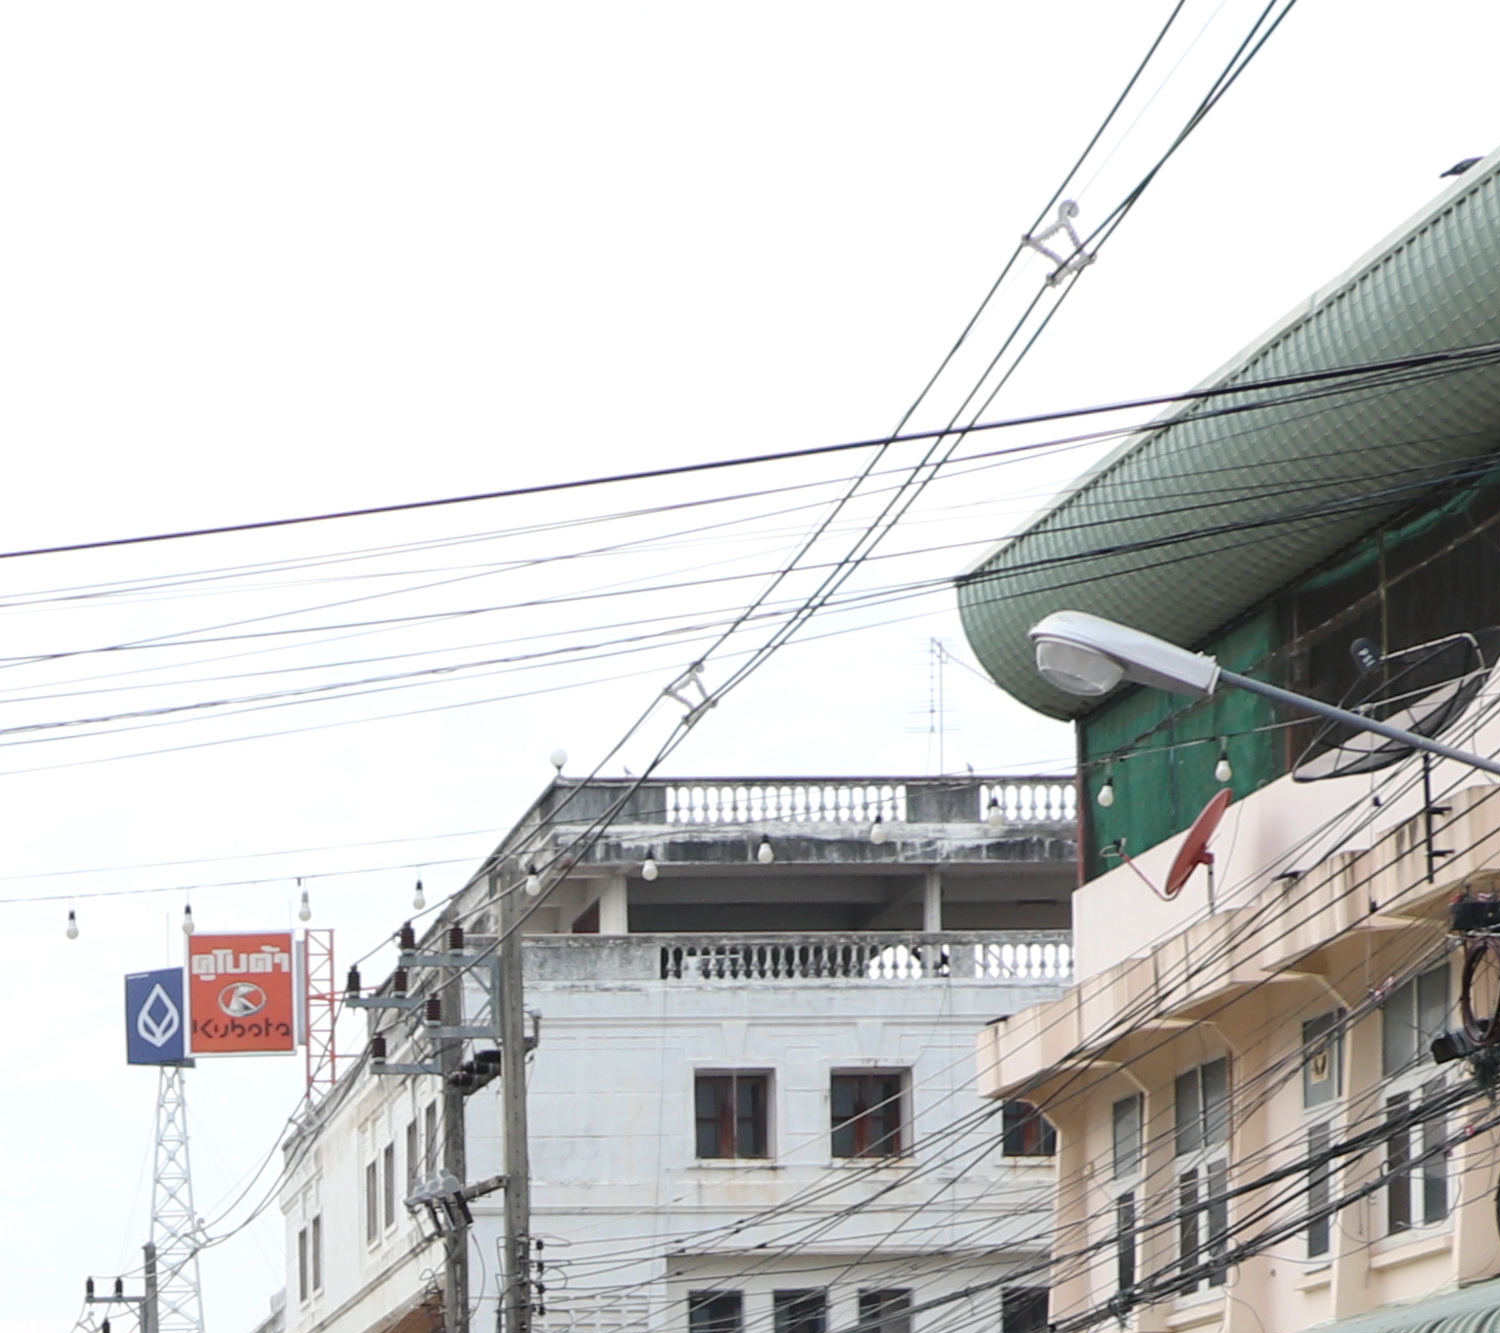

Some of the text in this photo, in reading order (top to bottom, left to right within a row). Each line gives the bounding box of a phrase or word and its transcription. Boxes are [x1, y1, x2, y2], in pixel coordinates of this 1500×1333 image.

[191, 945, 290, 981] คูโบต้า
[192, 1017, 291, 1038] Kubota
